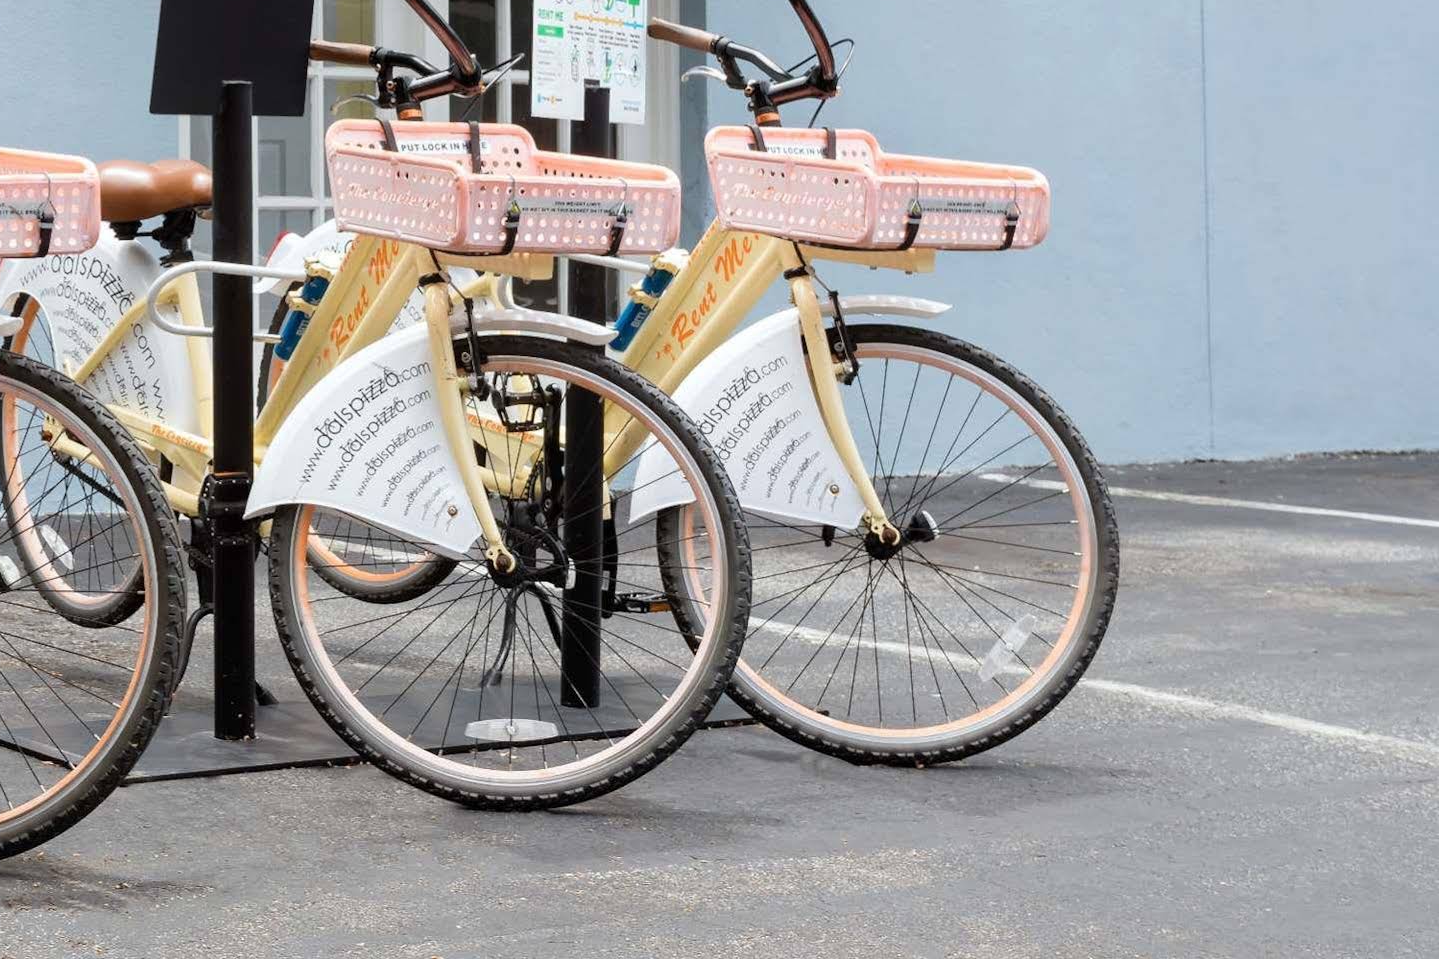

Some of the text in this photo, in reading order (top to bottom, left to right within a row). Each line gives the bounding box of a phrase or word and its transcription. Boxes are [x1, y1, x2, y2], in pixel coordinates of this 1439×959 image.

[401, 143, 419, 151] PUT
[422, 143, 448, 151] LOCK
[462, 141, 488, 149] HE
[783, 146, 805, 154] LOCK
[347, 183, 368, 199] The
[331, 285, 369, 356] Rent
[671, 281, 717, 350] Rent
[715, 236, 753, 282] Me
[301, 362, 431, 483] www.dalspizza.com
[328, 389, 432, 491] www.dalspizza.com
